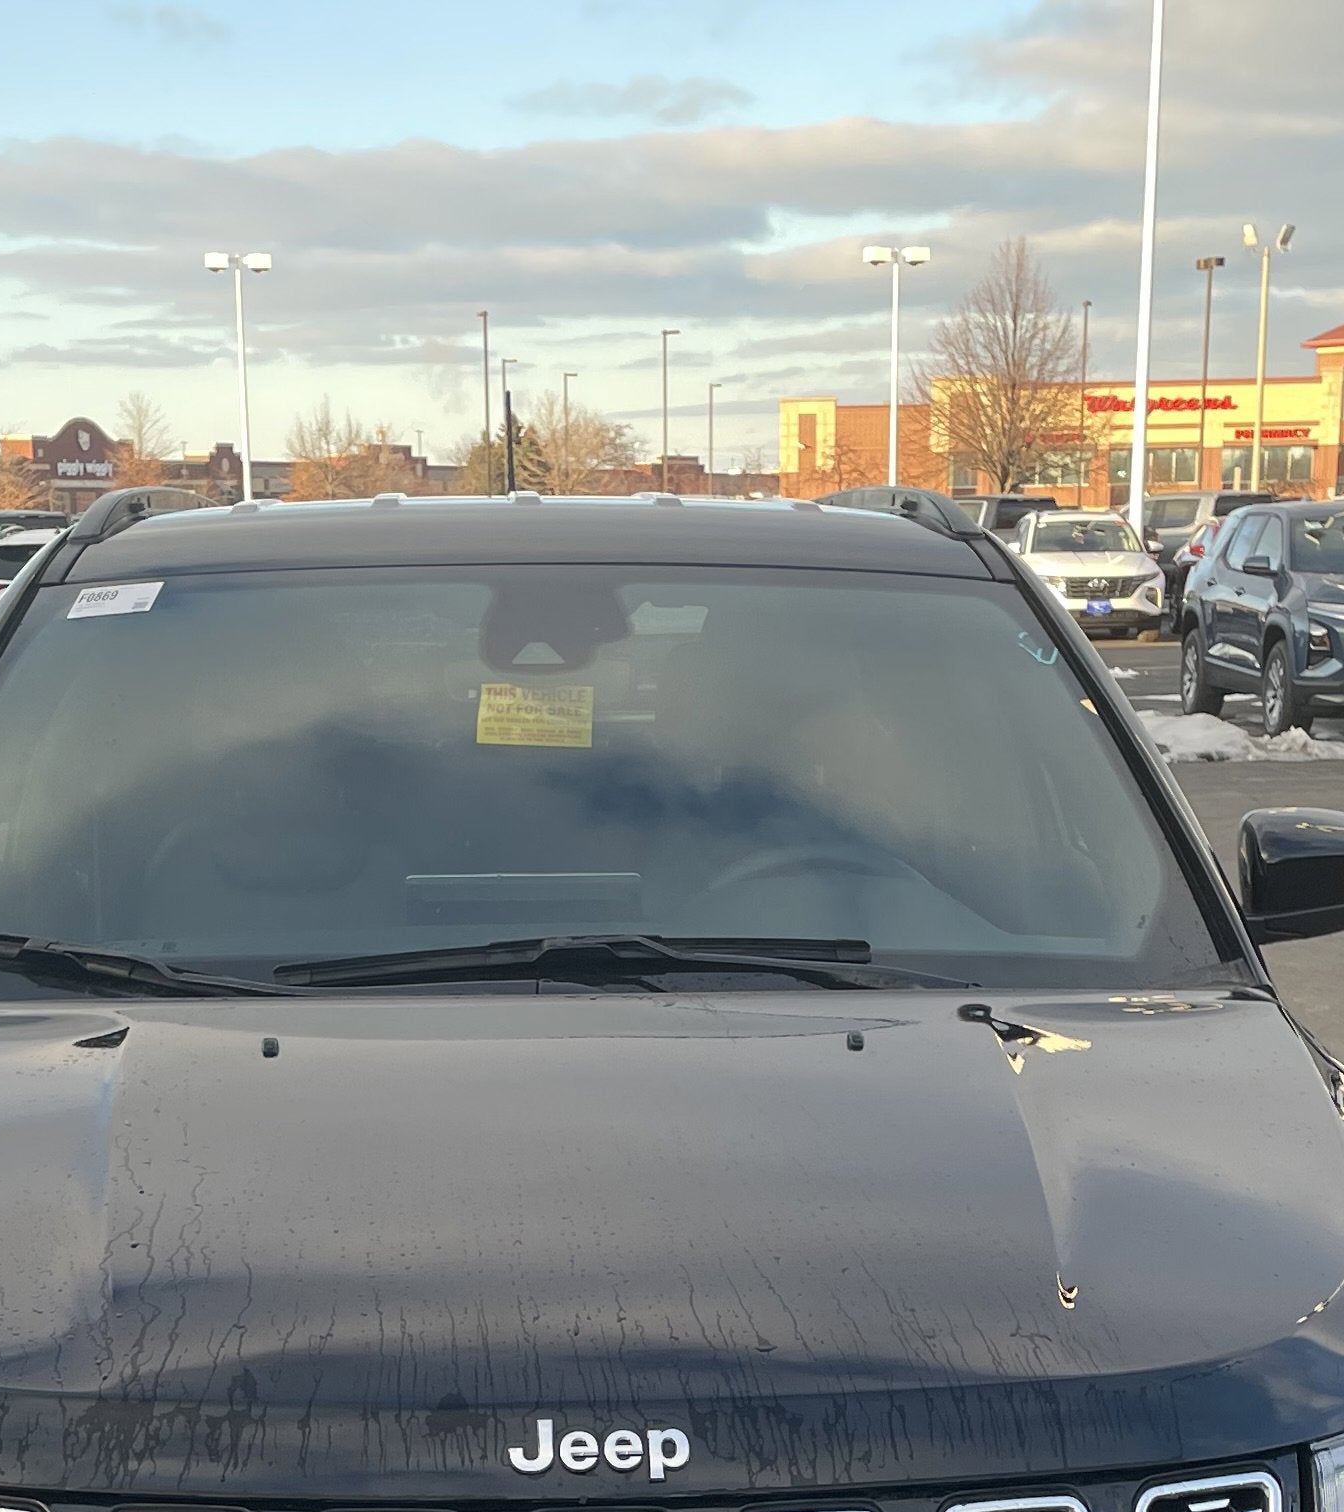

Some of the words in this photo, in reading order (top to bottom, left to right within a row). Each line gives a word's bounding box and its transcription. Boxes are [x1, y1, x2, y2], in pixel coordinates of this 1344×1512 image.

[1234, 428, 1311, 440] PHRMACY
[485, 687, 517, 699] THIS
[522, 688, 587, 704] VEHICLE
[486, 703, 513, 714] NOT
[516, 704, 543, 716] FOR
[545, 705, 583, 718] SALE
[508, 1418, 690, 1483] Jeep
